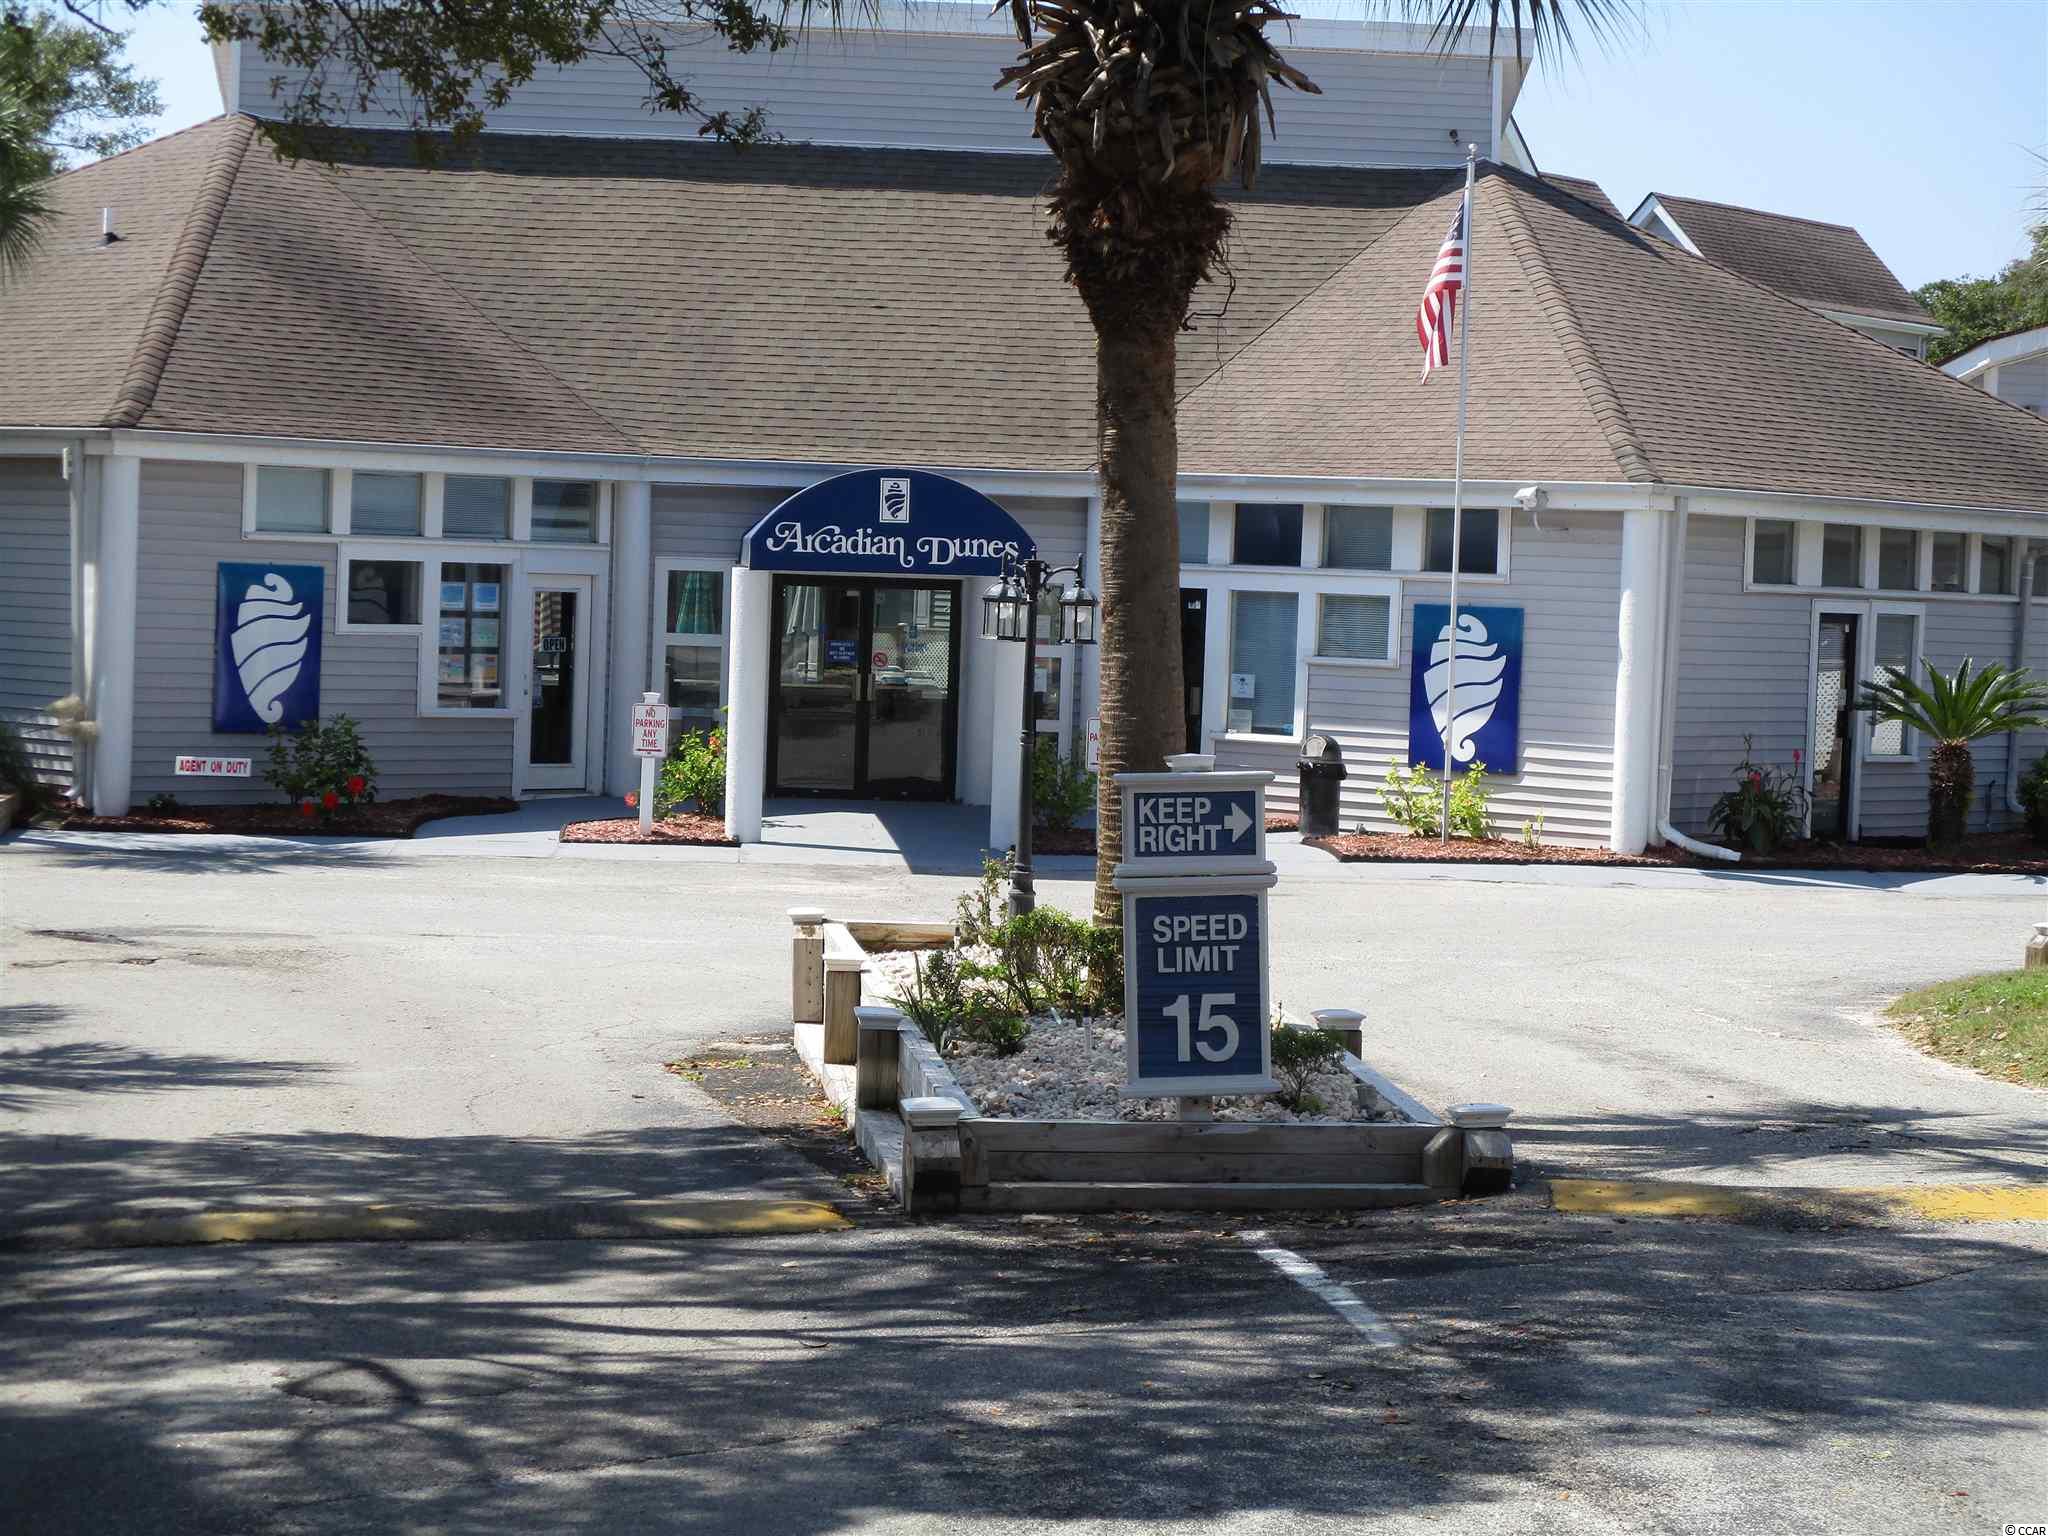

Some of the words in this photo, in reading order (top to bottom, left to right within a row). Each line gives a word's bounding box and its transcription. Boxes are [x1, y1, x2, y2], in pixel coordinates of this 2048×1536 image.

[766, 521, 913, 568] Arcadian
[917, 537, 1019, 565] Dunes
[543, 639, 565, 651] OPEN
[645, 708, 656, 718] NO
[635, 719, 665, 728] PARKING
[643, 729, 656, 738] ANY
[641, 739, 657, 748] TIME
[179, 760, 207, 772] AGENT
[211, 760, 222, 773] ON
[226, 761, 248, 774] DUTY
[1139, 797, 1211, 824] KEEP
[1139, 825, 1222, 853] RIGHT
[1152, 914, 1248, 943] SPEED
[1157, 945, 1240, 973] LIMIT
[1162, 992, 1240, 1063] 15
